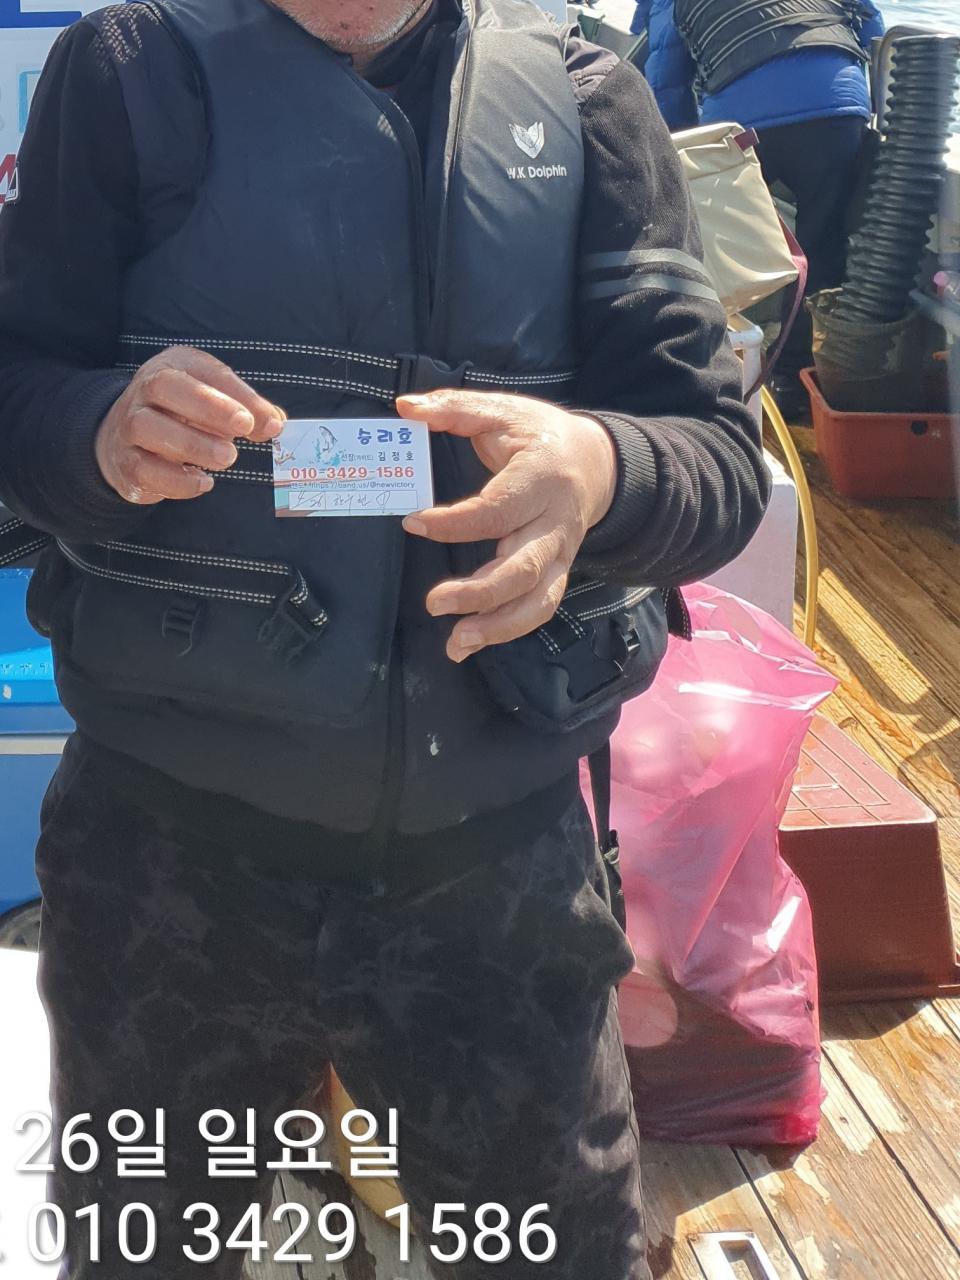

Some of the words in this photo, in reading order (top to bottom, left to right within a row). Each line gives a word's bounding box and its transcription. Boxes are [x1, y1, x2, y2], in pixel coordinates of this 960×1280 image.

[527, 164, 568, 179] Dolphin
[358, 428, 412, 445] 승리호
[291, 467, 414, 479] 010-3429-1586
